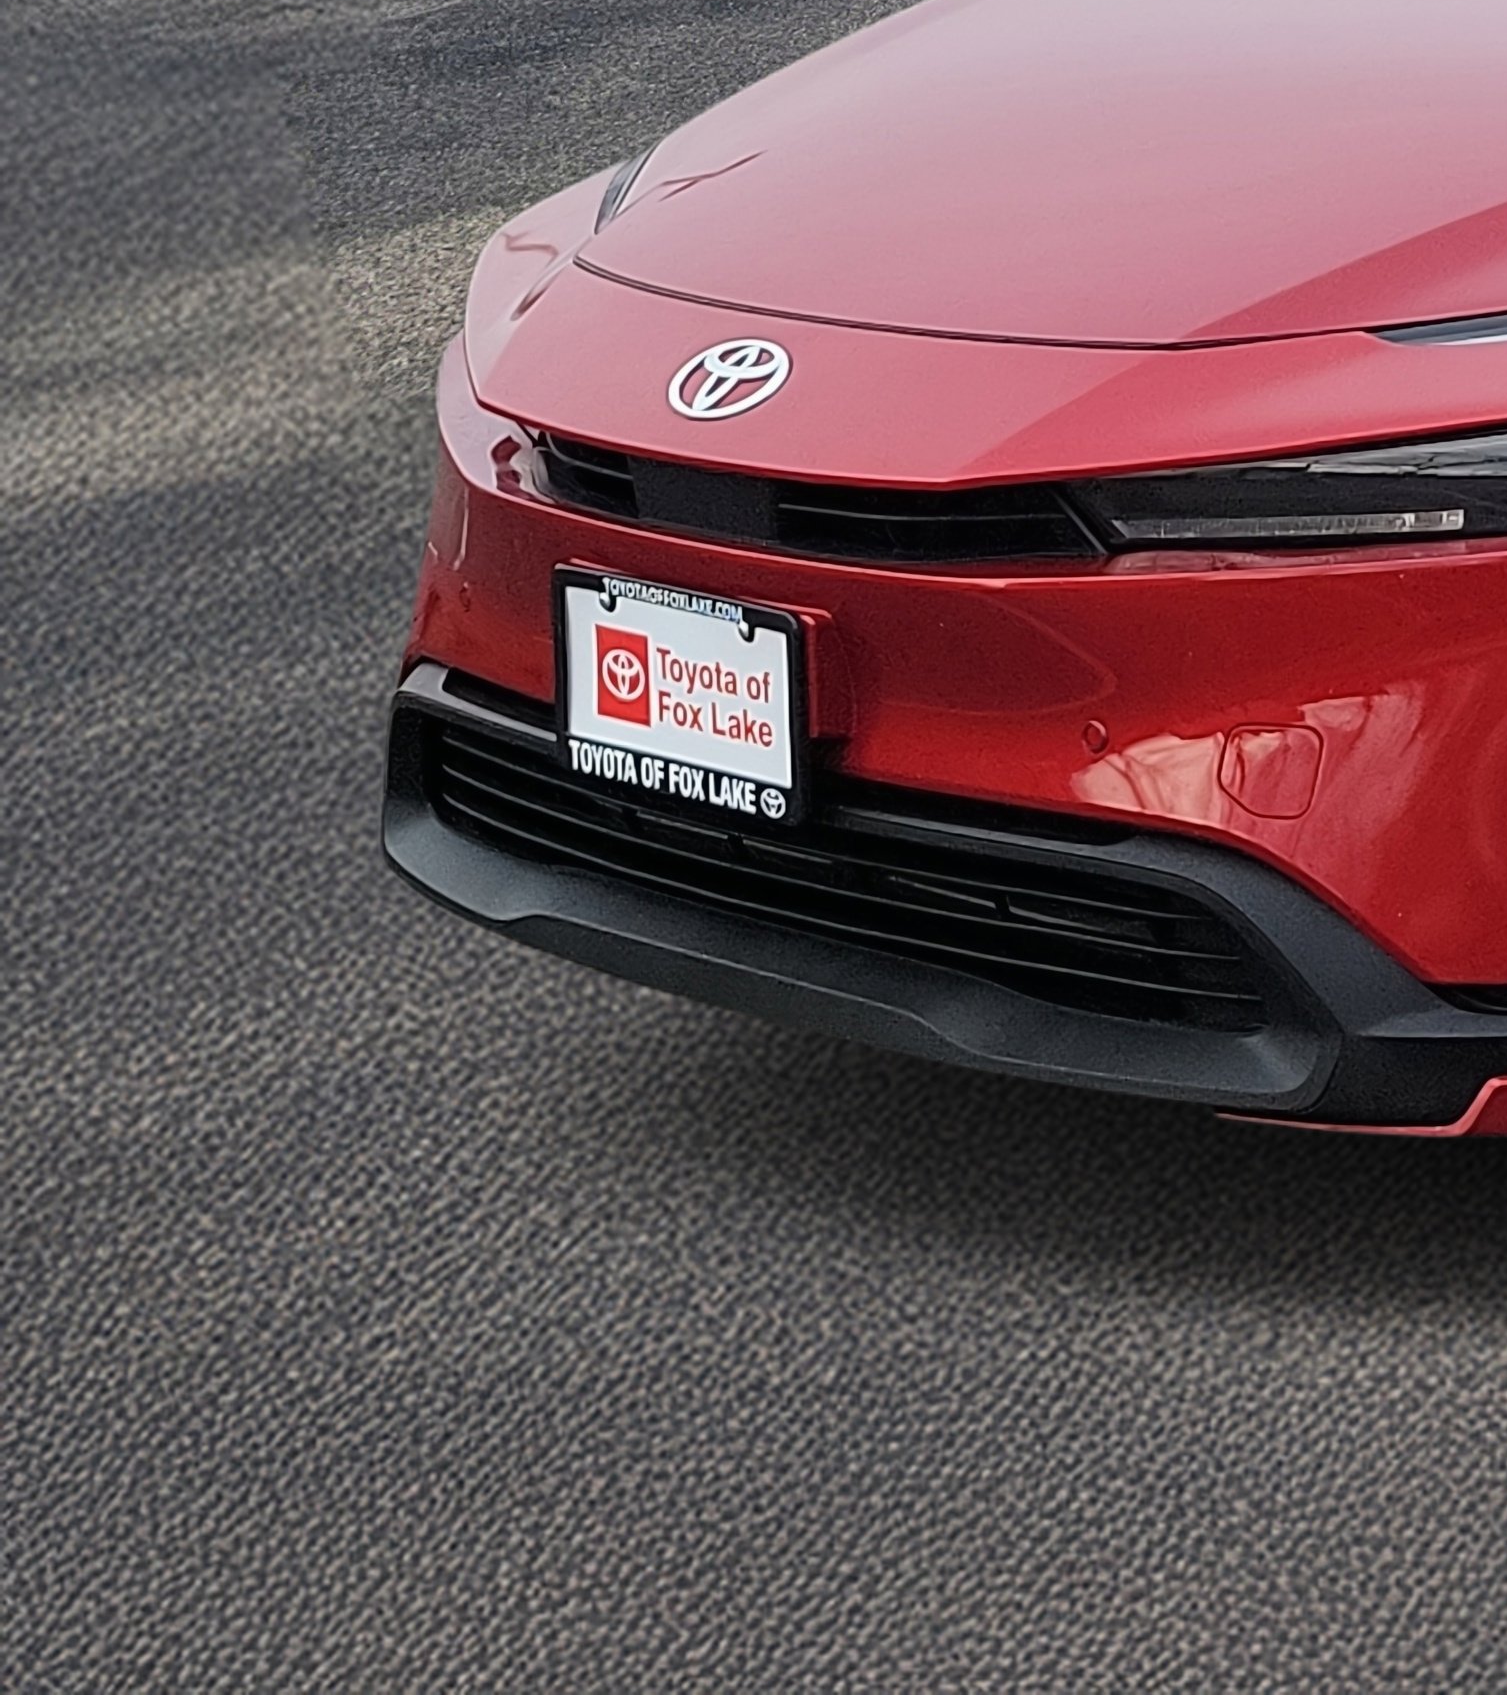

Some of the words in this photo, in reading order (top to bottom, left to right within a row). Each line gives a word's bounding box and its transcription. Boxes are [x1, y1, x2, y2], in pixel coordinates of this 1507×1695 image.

[656, 647, 738, 695] Toyota
[746, 672, 771, 704] of
[657, 690, 704, 733] Fox
[711, 702, 773, 747] Lake
[568, 739, 638, 785] TOYOTA
[640, 756, 665, 790] OF
[668, 762, 706, 802] FOX
[708, 772, 757, 814] LAKE
